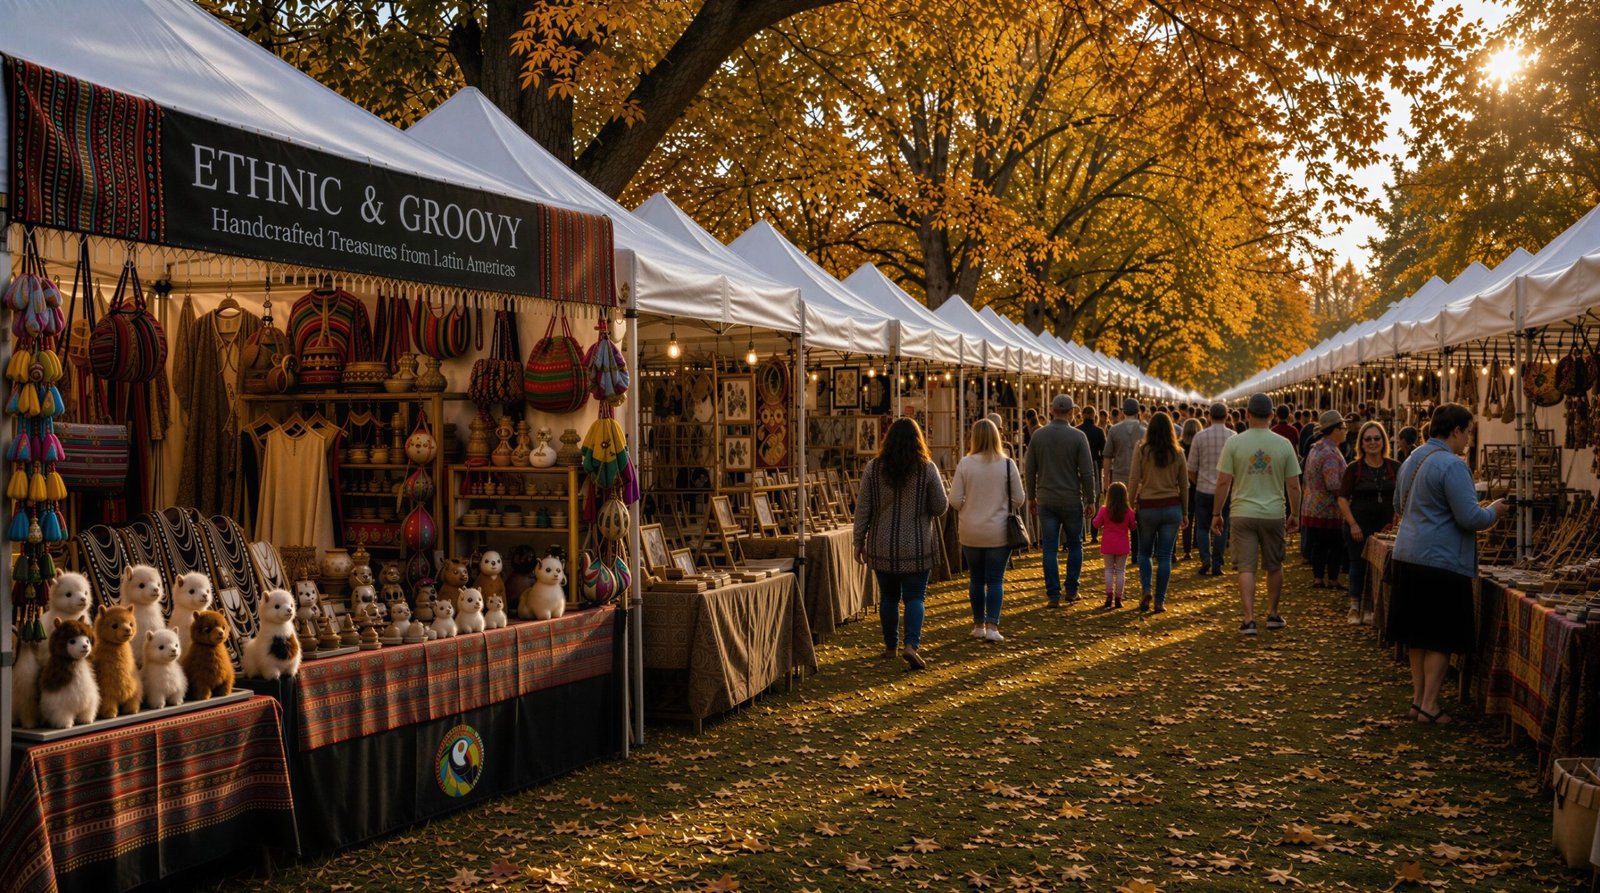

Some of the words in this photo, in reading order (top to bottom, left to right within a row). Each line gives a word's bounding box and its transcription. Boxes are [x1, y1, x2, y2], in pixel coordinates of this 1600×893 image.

[192, 144, 342, 215] ETHNIC
[361, 186, 385, 226] &
[400, 195, 521, 249] GROOVY
[212, 208, 325, 247] Handcrafted
[328, 231, 398, 260] Treasures
[401, 244, 431, 266] from
[435, 250, 464, 271] Latin
[467, 256, 516, 278] Americas
